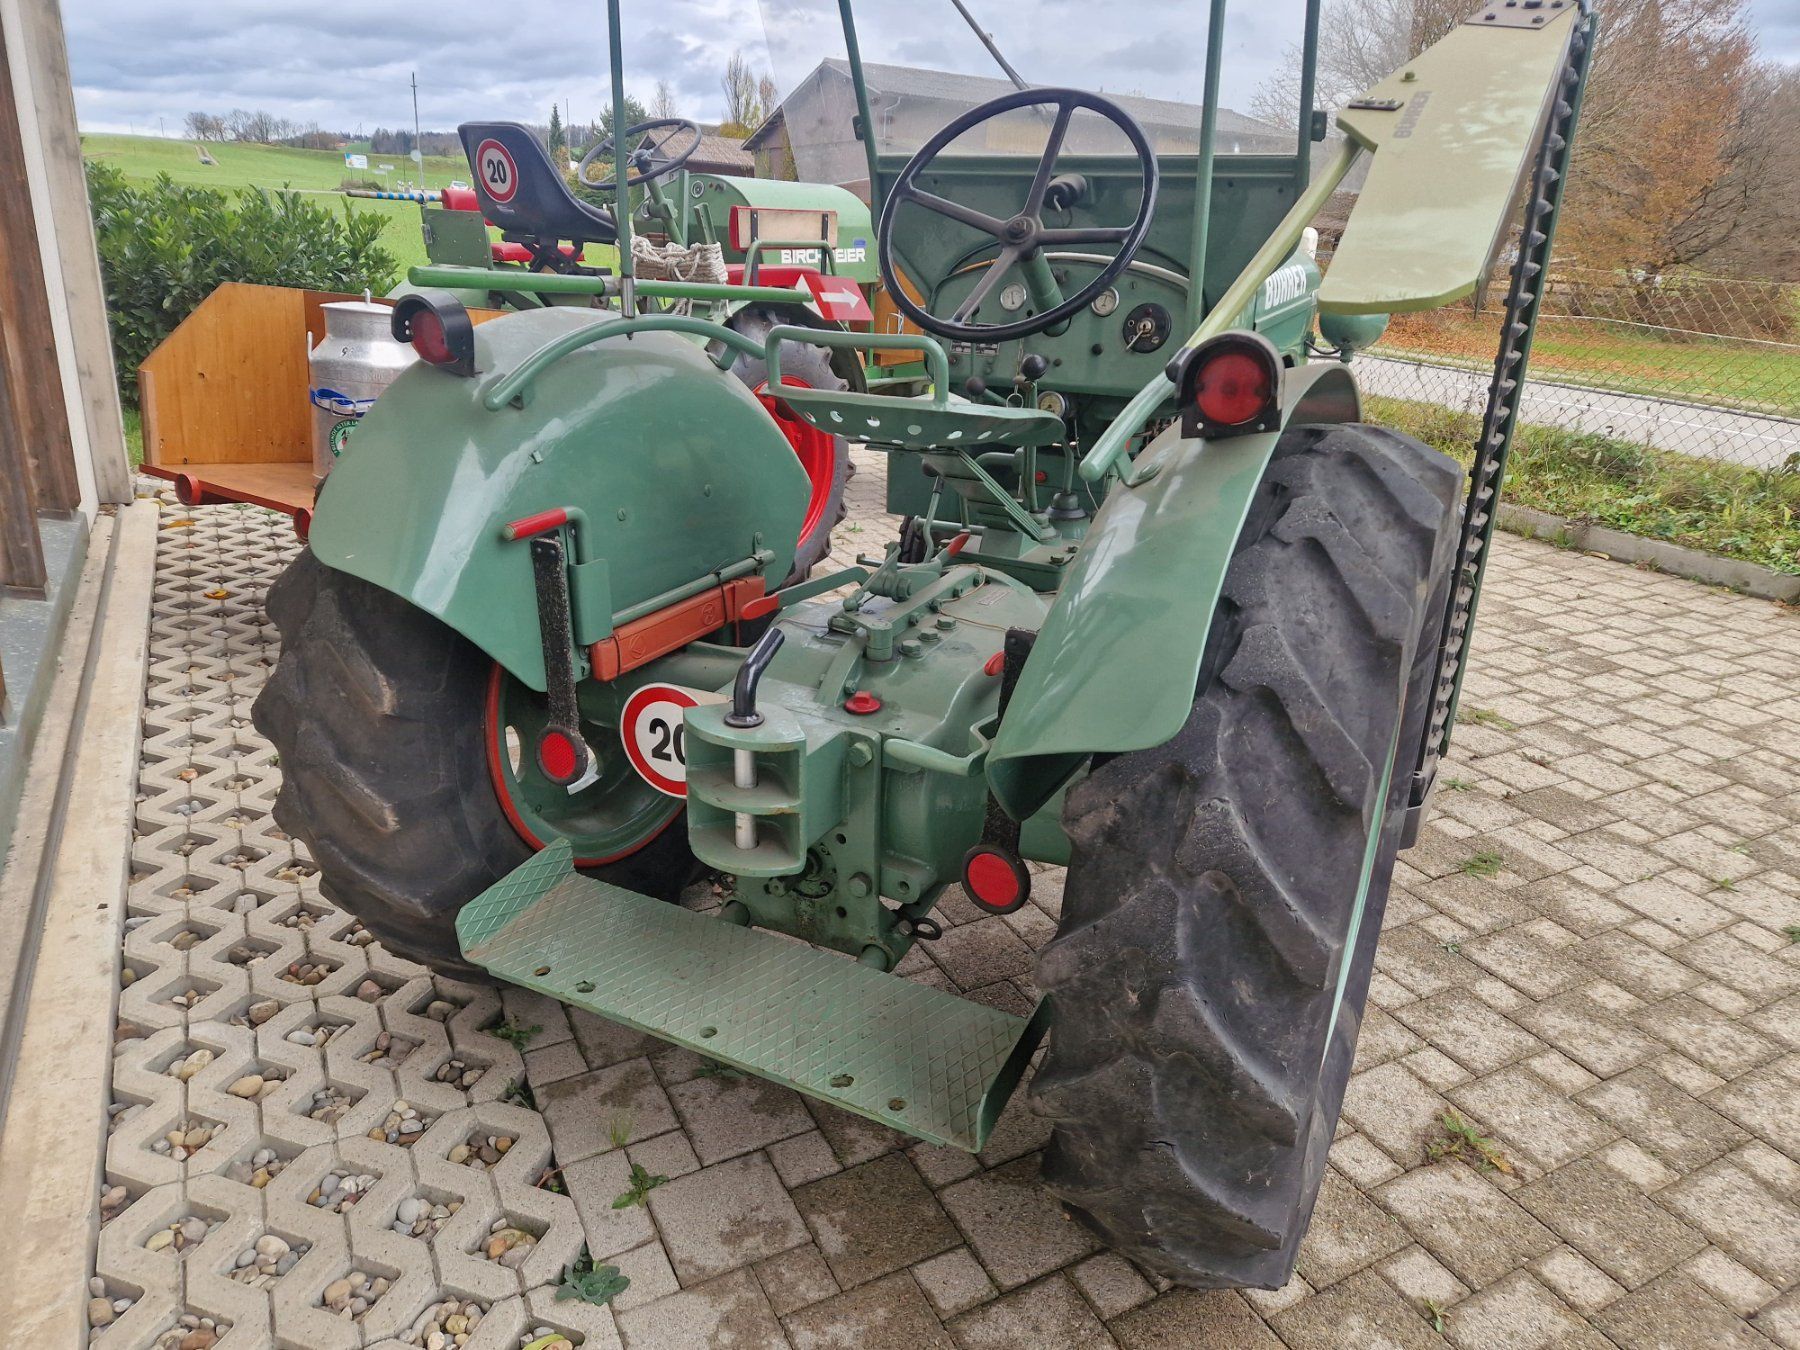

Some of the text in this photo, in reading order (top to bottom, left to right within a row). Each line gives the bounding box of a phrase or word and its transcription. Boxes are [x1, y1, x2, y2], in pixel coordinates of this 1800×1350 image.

[487, 159, 507, 184] 20
[781, 248, 866, 264] BIRCHEIER
[649, 717, 686, 766] 20
